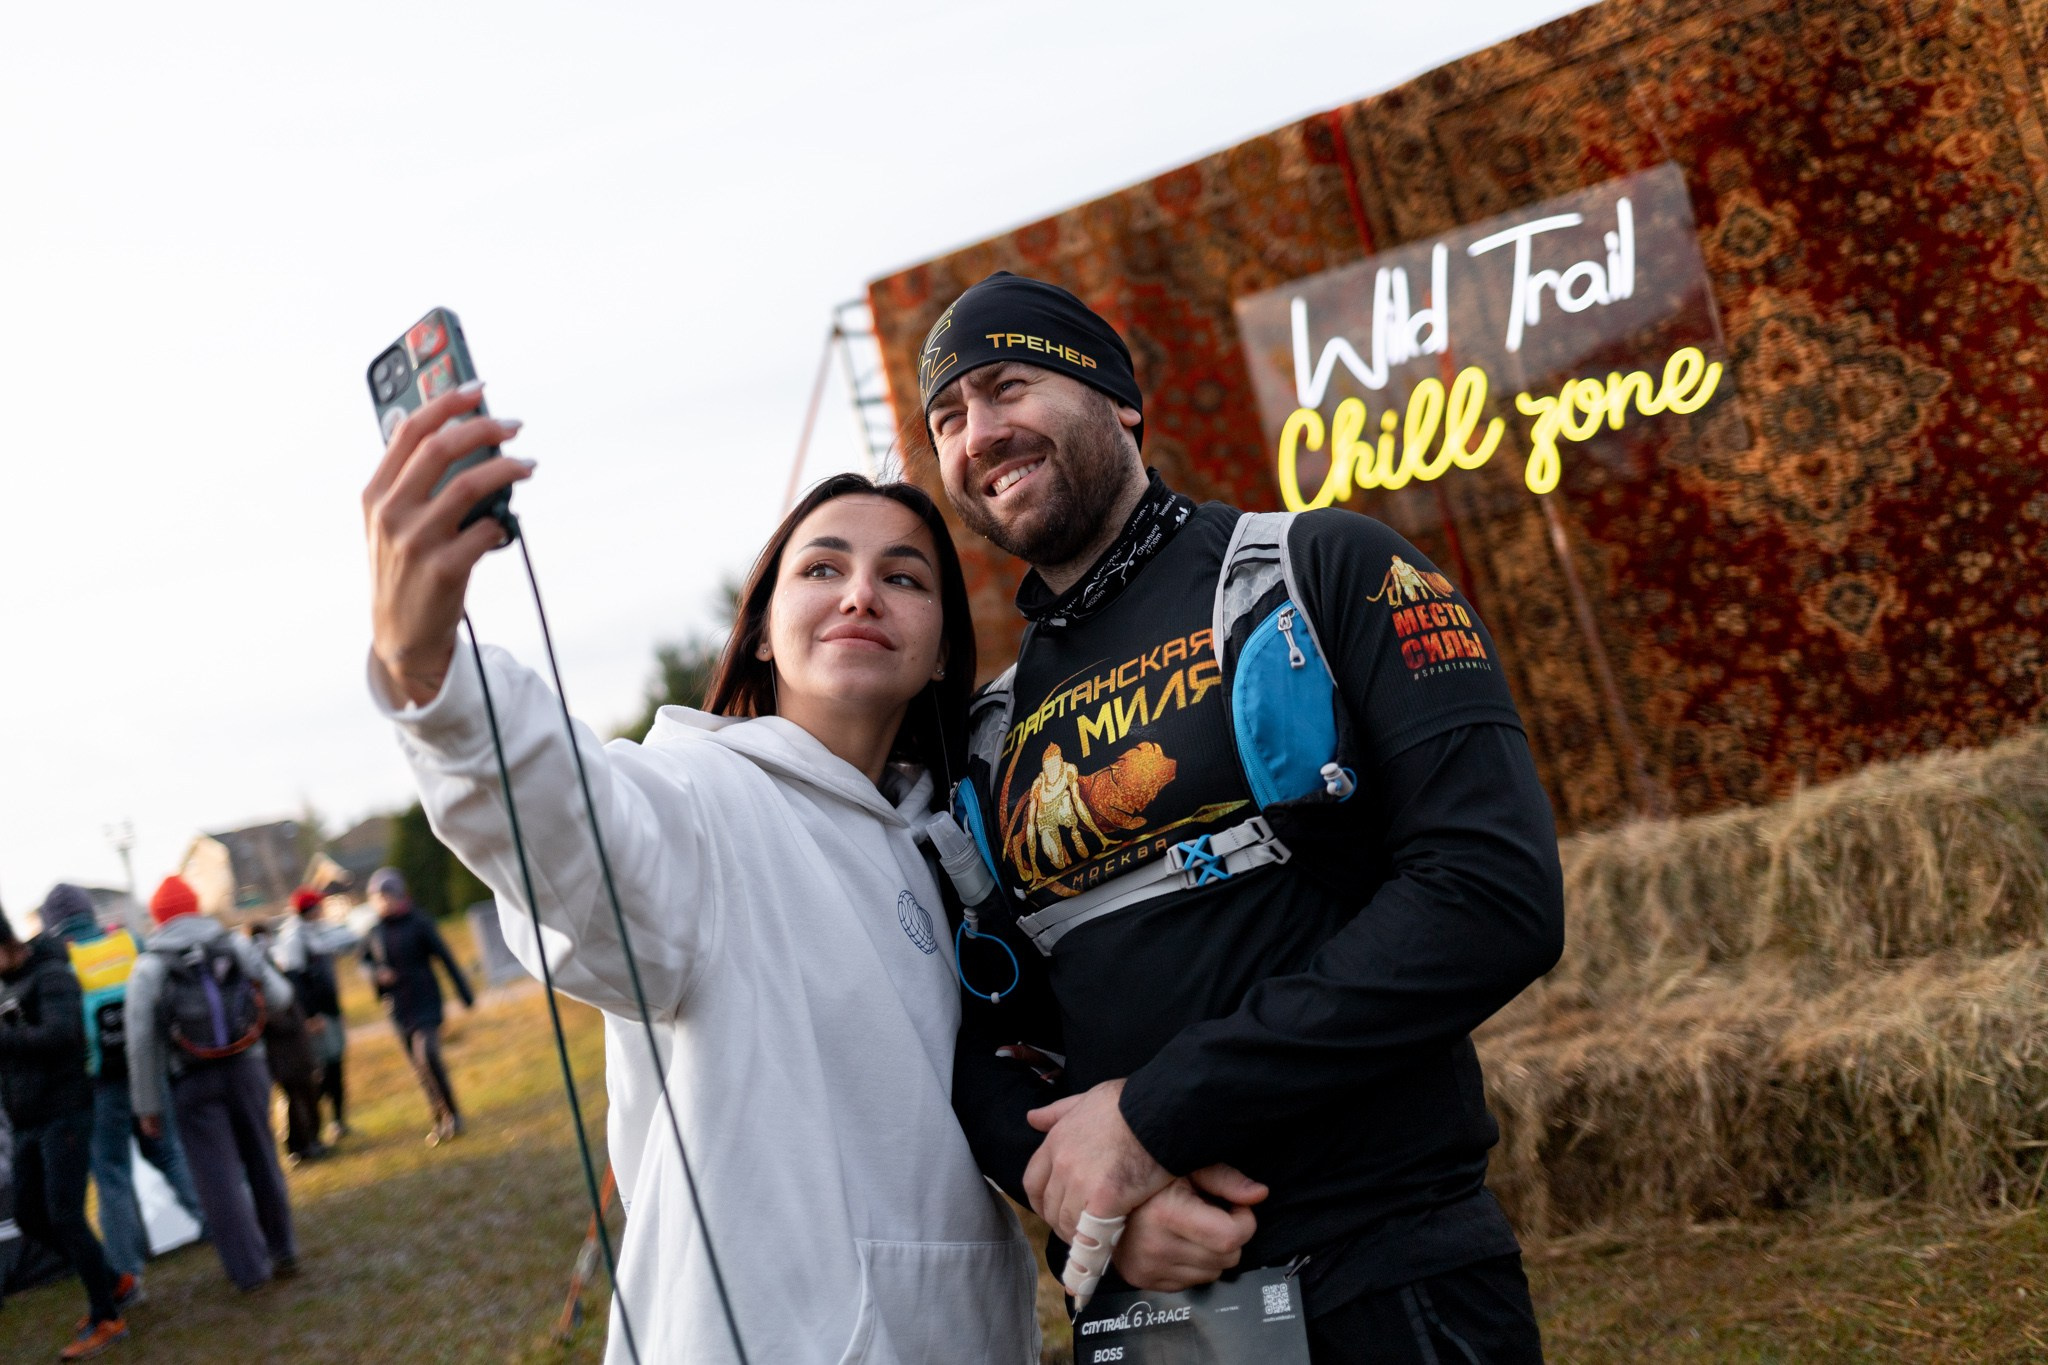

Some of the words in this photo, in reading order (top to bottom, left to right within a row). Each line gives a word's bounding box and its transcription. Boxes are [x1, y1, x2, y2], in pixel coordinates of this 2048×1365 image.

[1291, 243, 1449, 410] Wild
[1467, 197, 1636, 353] Trail
[985, 333, 1097, 369] ТРЕНЕР
[1278, 366, 1506, 513] Chill
[1515, 347, 1724, 494] zone
[1392, 602, 1472, 638] МЕСТО
[1401, 630, 1488, 670] СИЛЫ
[1077, 659, 1222, 758] МИЛЯ
[1072, 838, 1168, 887] МОСКВА
[1145, 1306, 1191, 1326] X-RACE
[1093, 1346, 1124, 1363] BOSS
